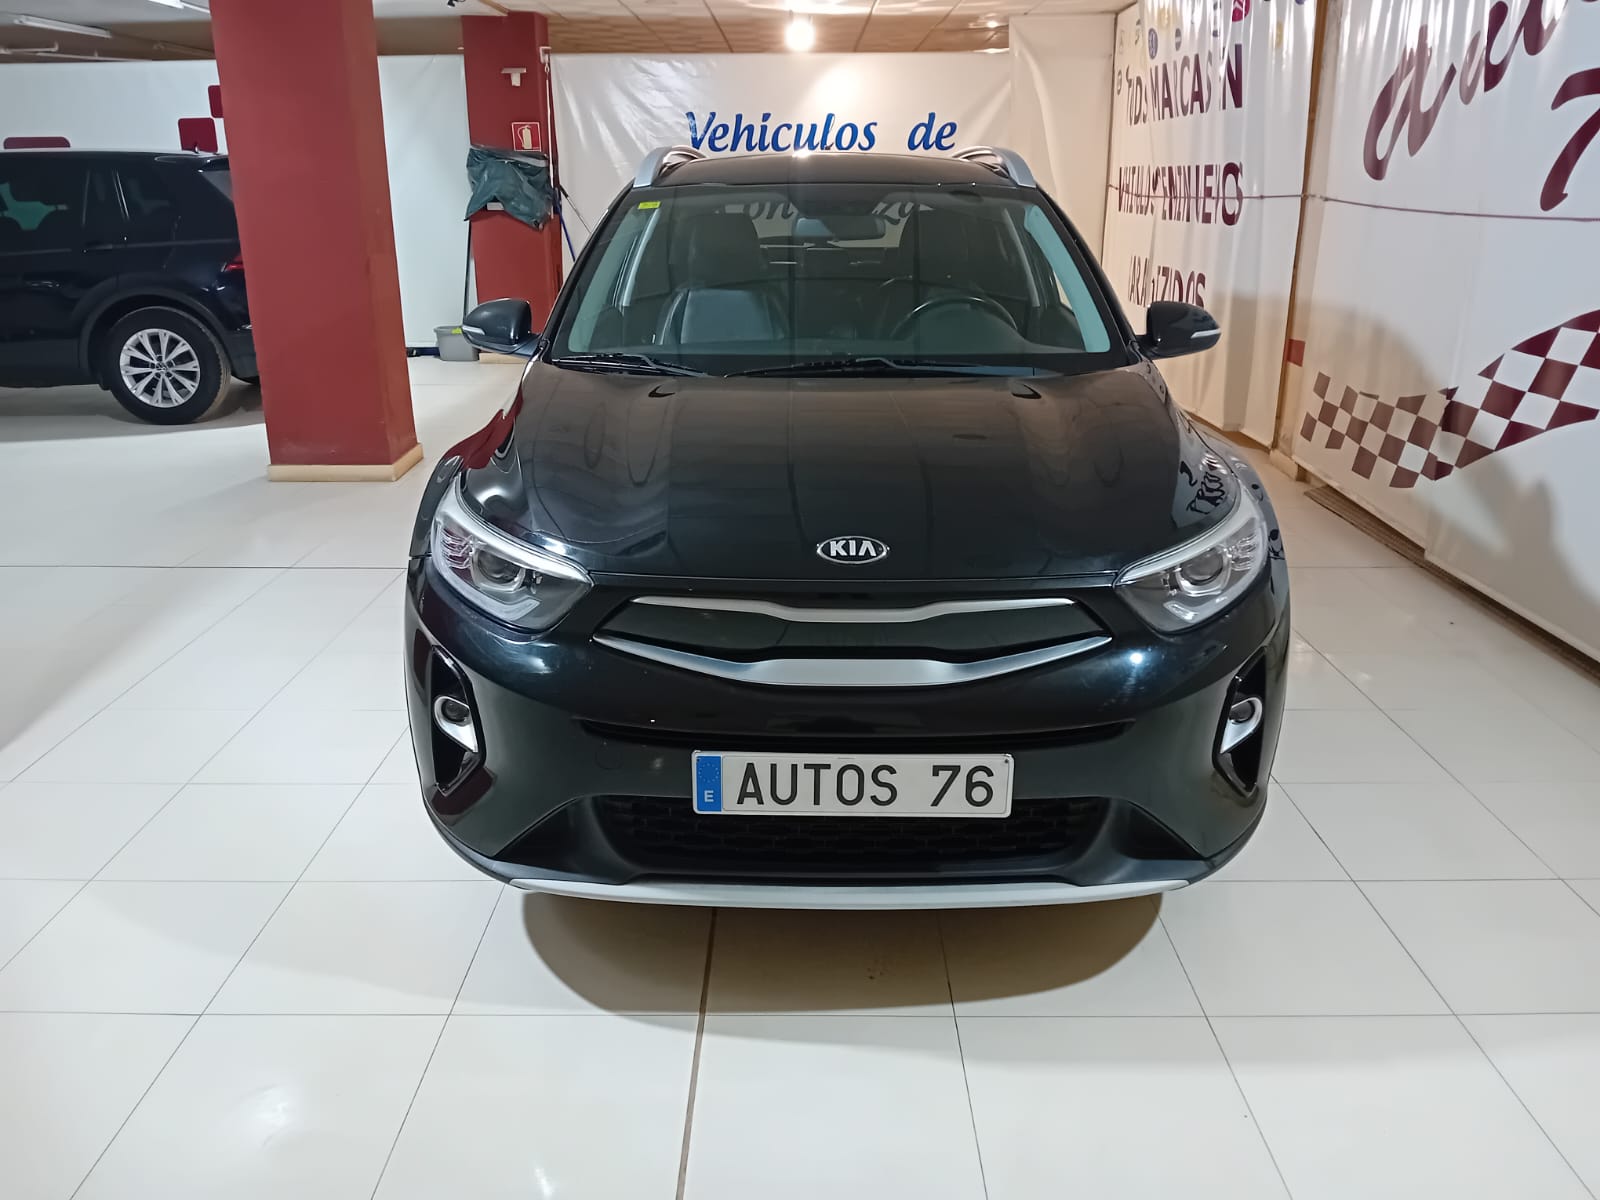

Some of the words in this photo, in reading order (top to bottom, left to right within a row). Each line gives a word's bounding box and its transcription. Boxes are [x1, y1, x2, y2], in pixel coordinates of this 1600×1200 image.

[907, 111, 957, 151] de
[829, 540, 877, 557] KIA
[703, 790, 715, 803] E
[736, 762, 898, 807] AUTOS
[930, 764, 994, 807] 76
